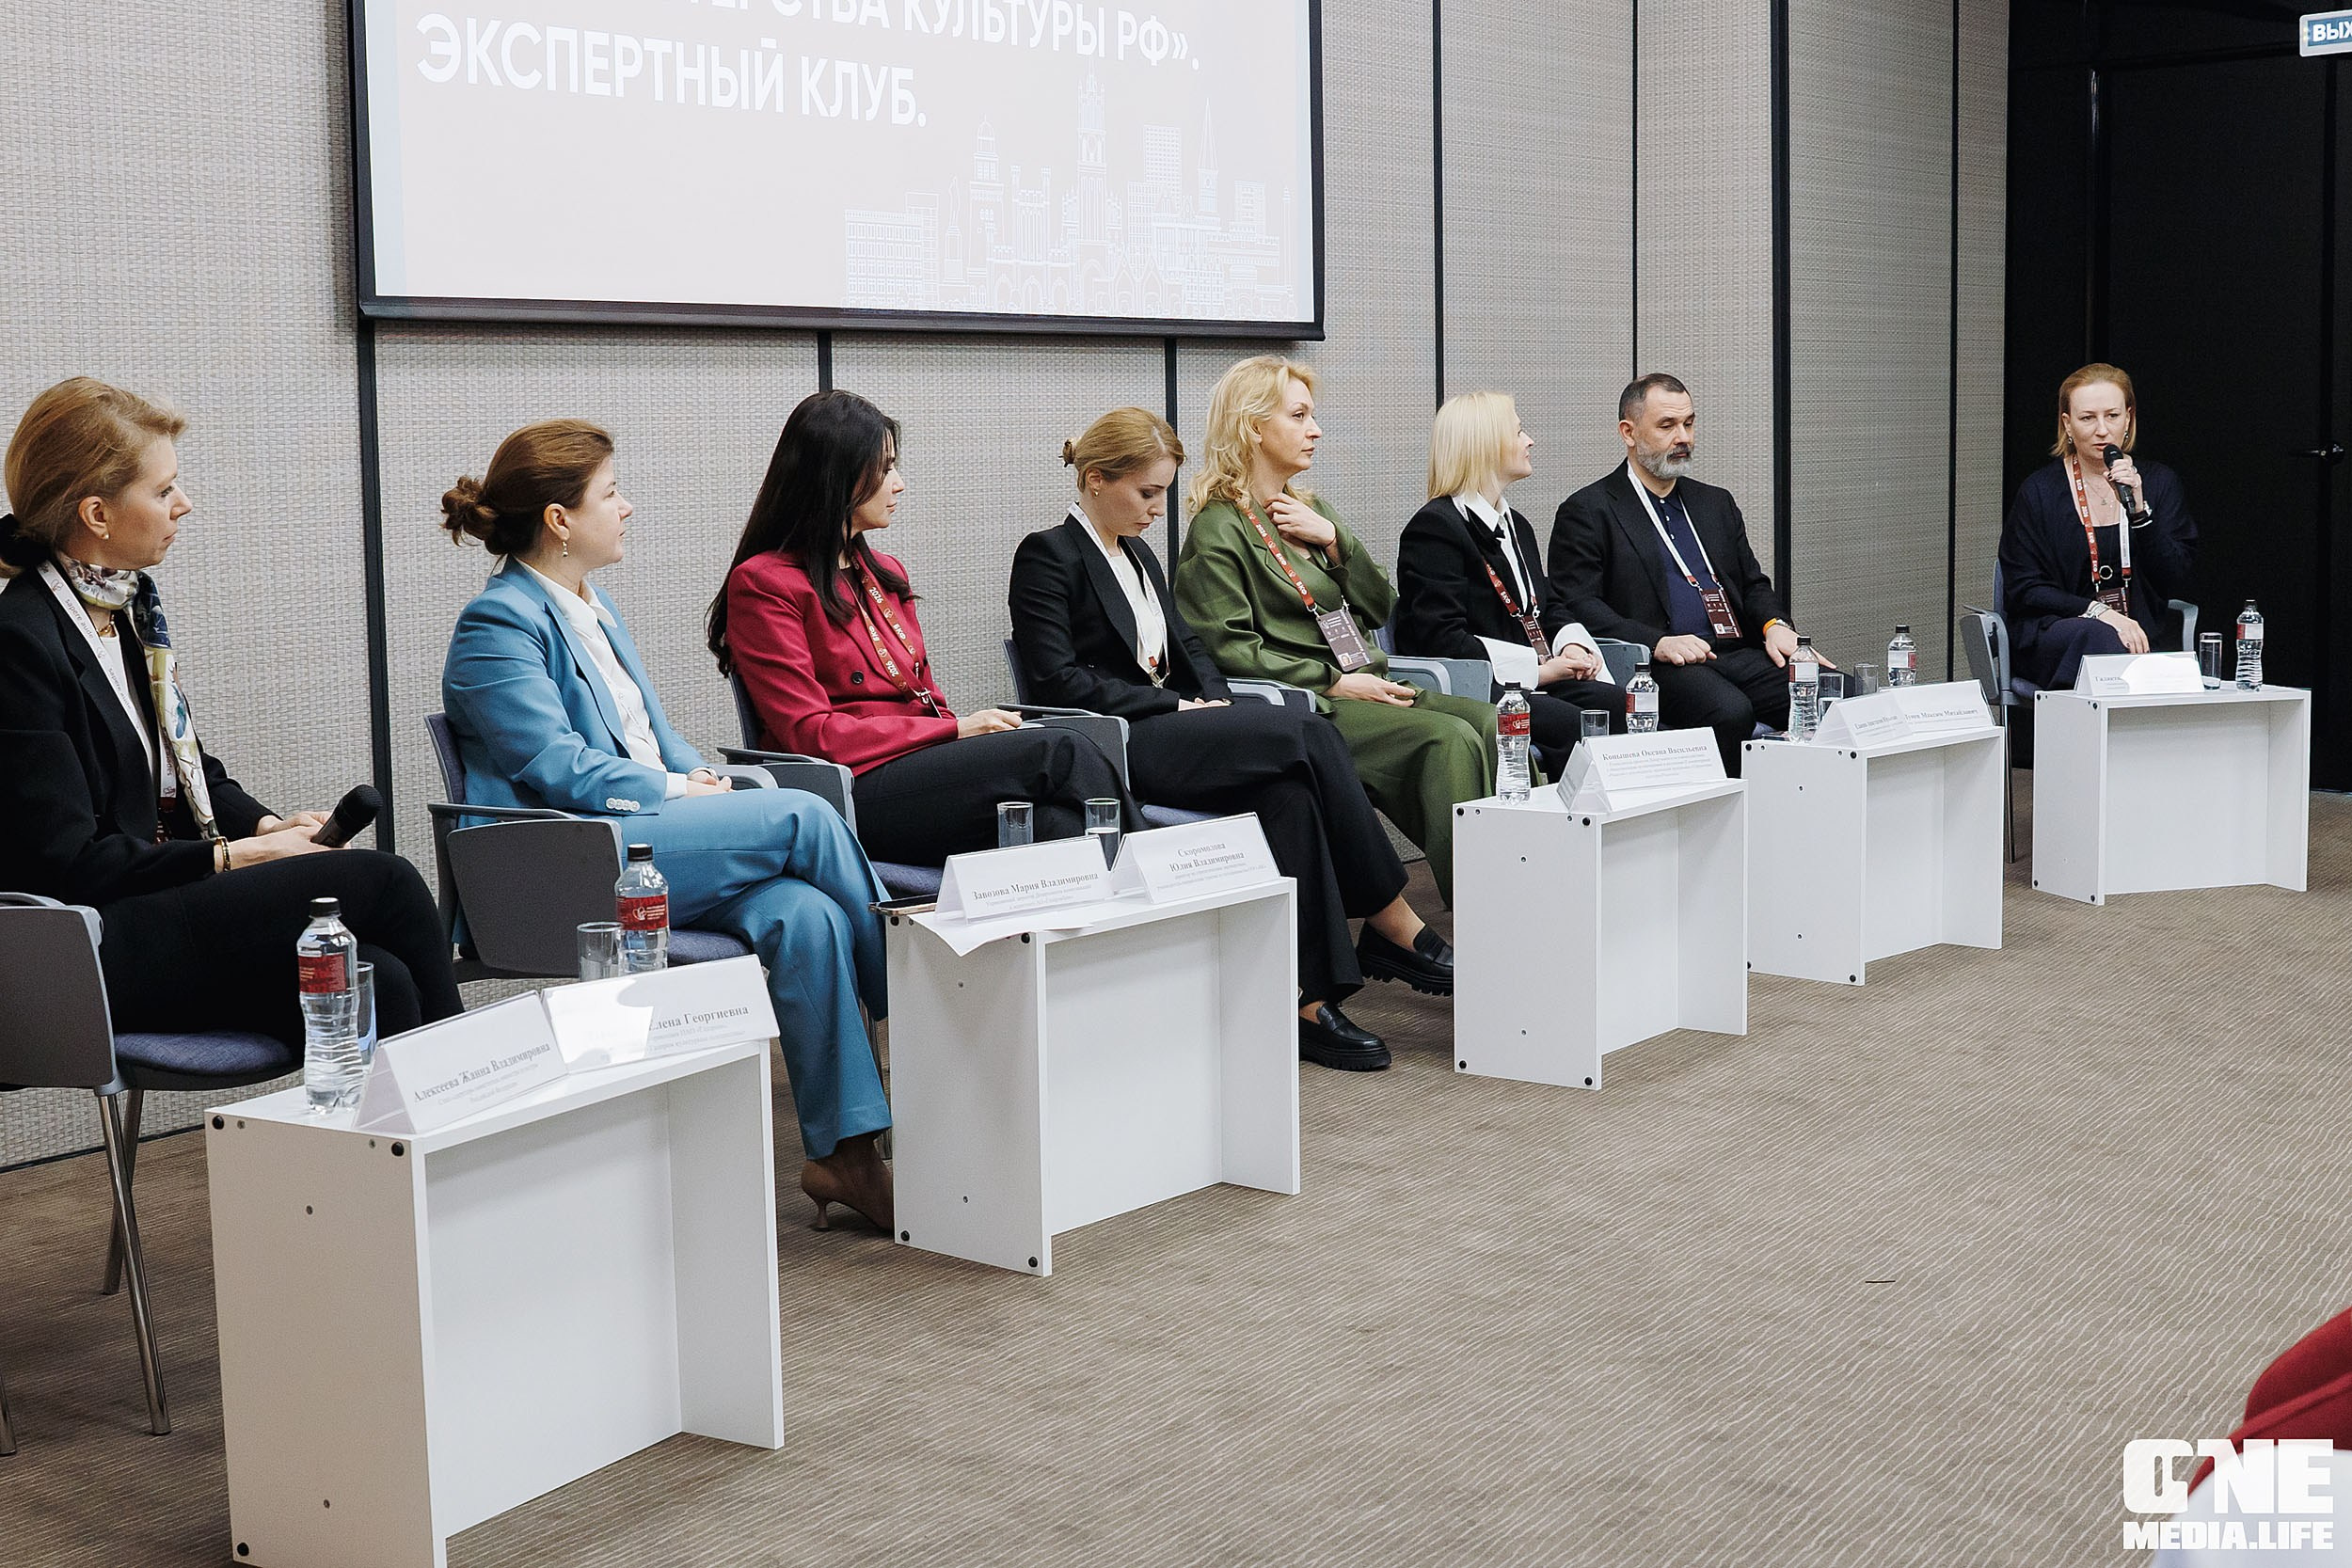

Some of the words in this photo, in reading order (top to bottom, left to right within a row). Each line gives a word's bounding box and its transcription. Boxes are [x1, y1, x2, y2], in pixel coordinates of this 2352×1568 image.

[904, 0, 1105, 57] КУЛЬТУРЫ
[1117, 9, 1200, 71] РФ».
[416, 13, 785, 114] ЭКСПЕРТНЫЙ
[801, 55, 927, 128] КЛУБ.
[869, 587, 883, 603] 2026
[65, 598, 82, 621] sapere
[80, 622, 94, 638] aude
[1169, 861, 1193, 873] Юлия
[1193, 852, 1245, 867] Владимировна
[973, 887, 1009, 900] Завозова
[1011, 881, 1040, 894] Мария
[1041, 872, 1099, 889] Владимировна
[684, 1006, 749, 1024] Георгиевна
[414, 1077, 460, 1103] Алексеева
[459, 1066, 491, 1085] Жанна
[490, 1043, 550, 1072] Владимировна
